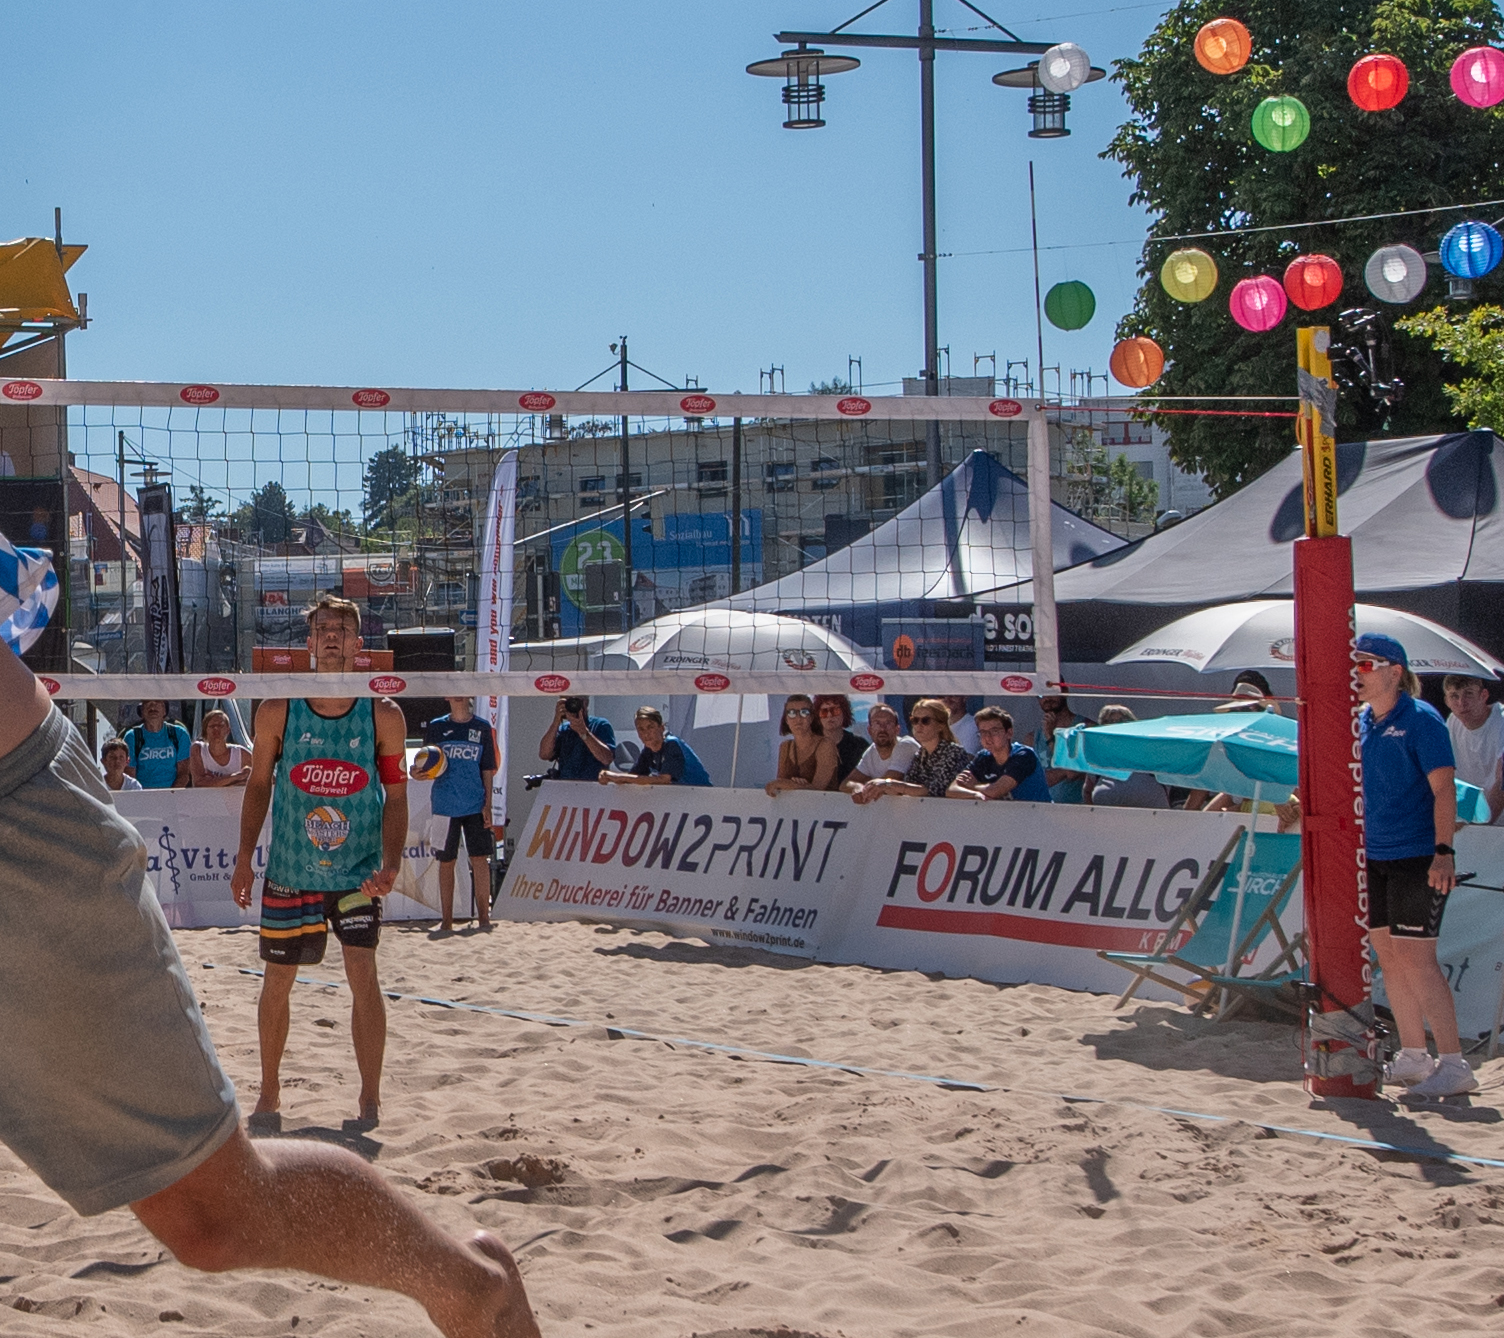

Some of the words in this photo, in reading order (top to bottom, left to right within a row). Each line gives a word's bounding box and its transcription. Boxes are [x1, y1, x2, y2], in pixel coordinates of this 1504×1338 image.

[1323, 456, 1335, 528] ERHARD
[895, 643, 913, 659] db
[663, 655, 711, 666] ERDINGER
[139, 747, 176, 761] SIRCH
[441, 744, 480, 761] SIRCH
[301, 764, 360, 788] Töpfer
[309, 785, 348, 796] Babywelt
[304, 817, 351, 831] BEACH
[190, 872, 220, 881] GmbH
[886, 839, 1067, 912] FORUM
[510, 874, 543, 901] Ihre
[544, 877, 629, 909] Druckerei
[625, 885, 654, 913] für
[653, 889, 723, 921] Banner
[723, 896, 740, 922] &
[742, 897, 818, 930] Fahnen
[710, 927, 806, 949] www.window2print.de
